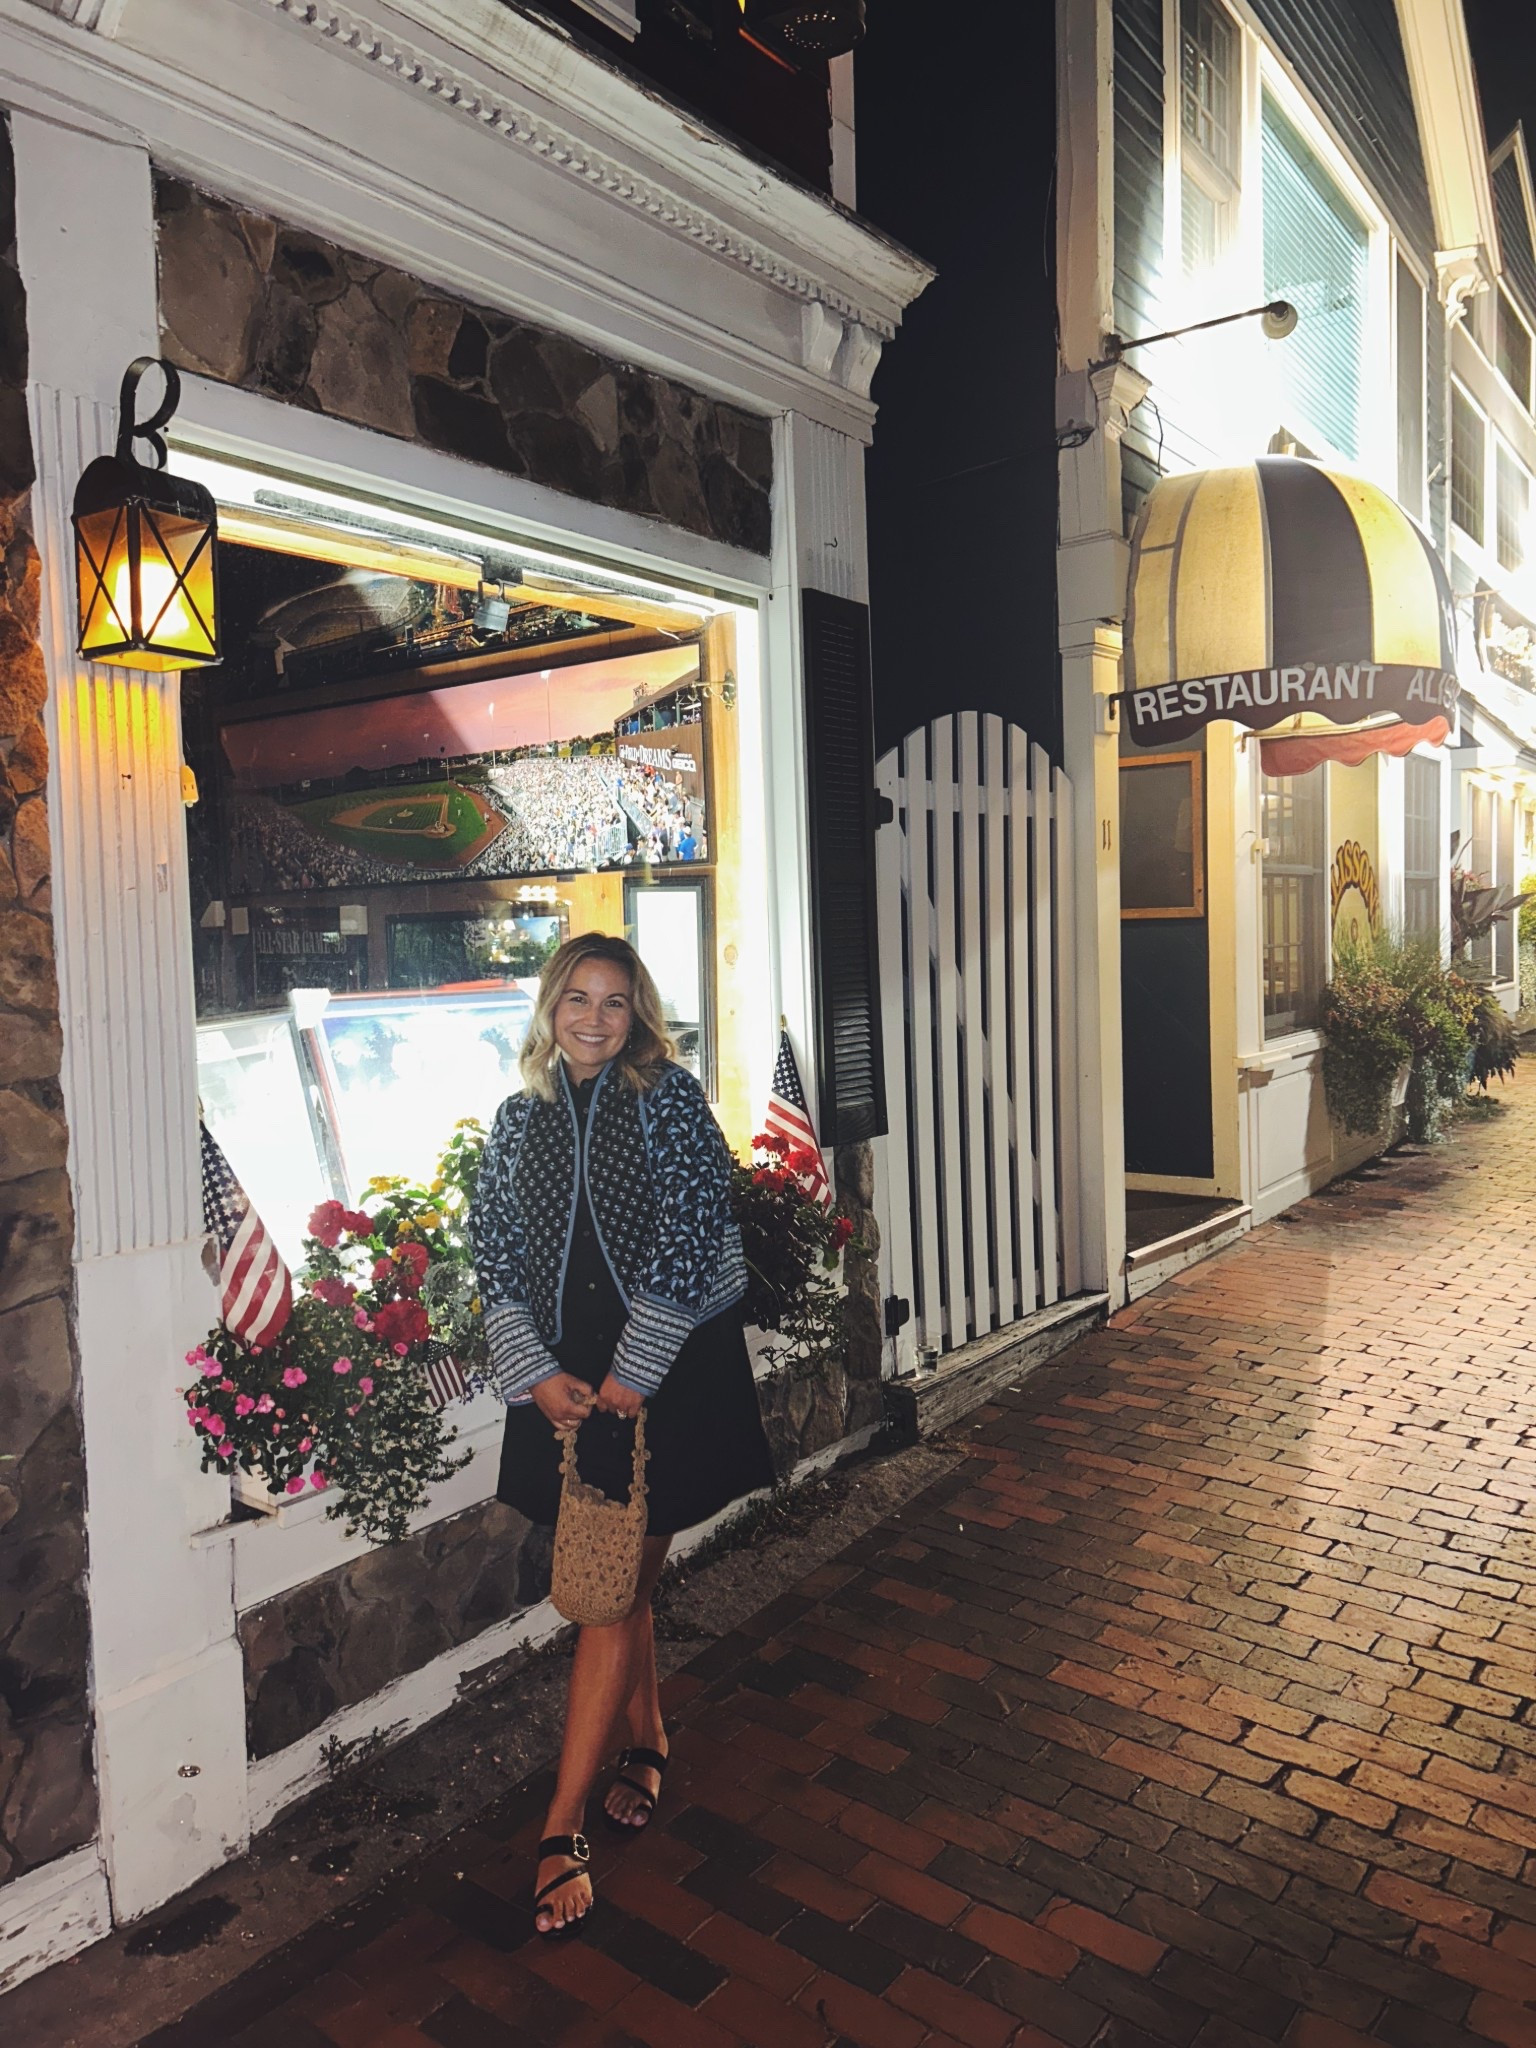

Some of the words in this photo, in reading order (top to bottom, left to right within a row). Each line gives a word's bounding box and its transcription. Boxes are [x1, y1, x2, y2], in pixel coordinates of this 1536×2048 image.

[1133, 665, 1383, 726] RESTAURANT
[640, 745, 672, 770] DREAMS
[1102, 819, 1111, 850] 11
